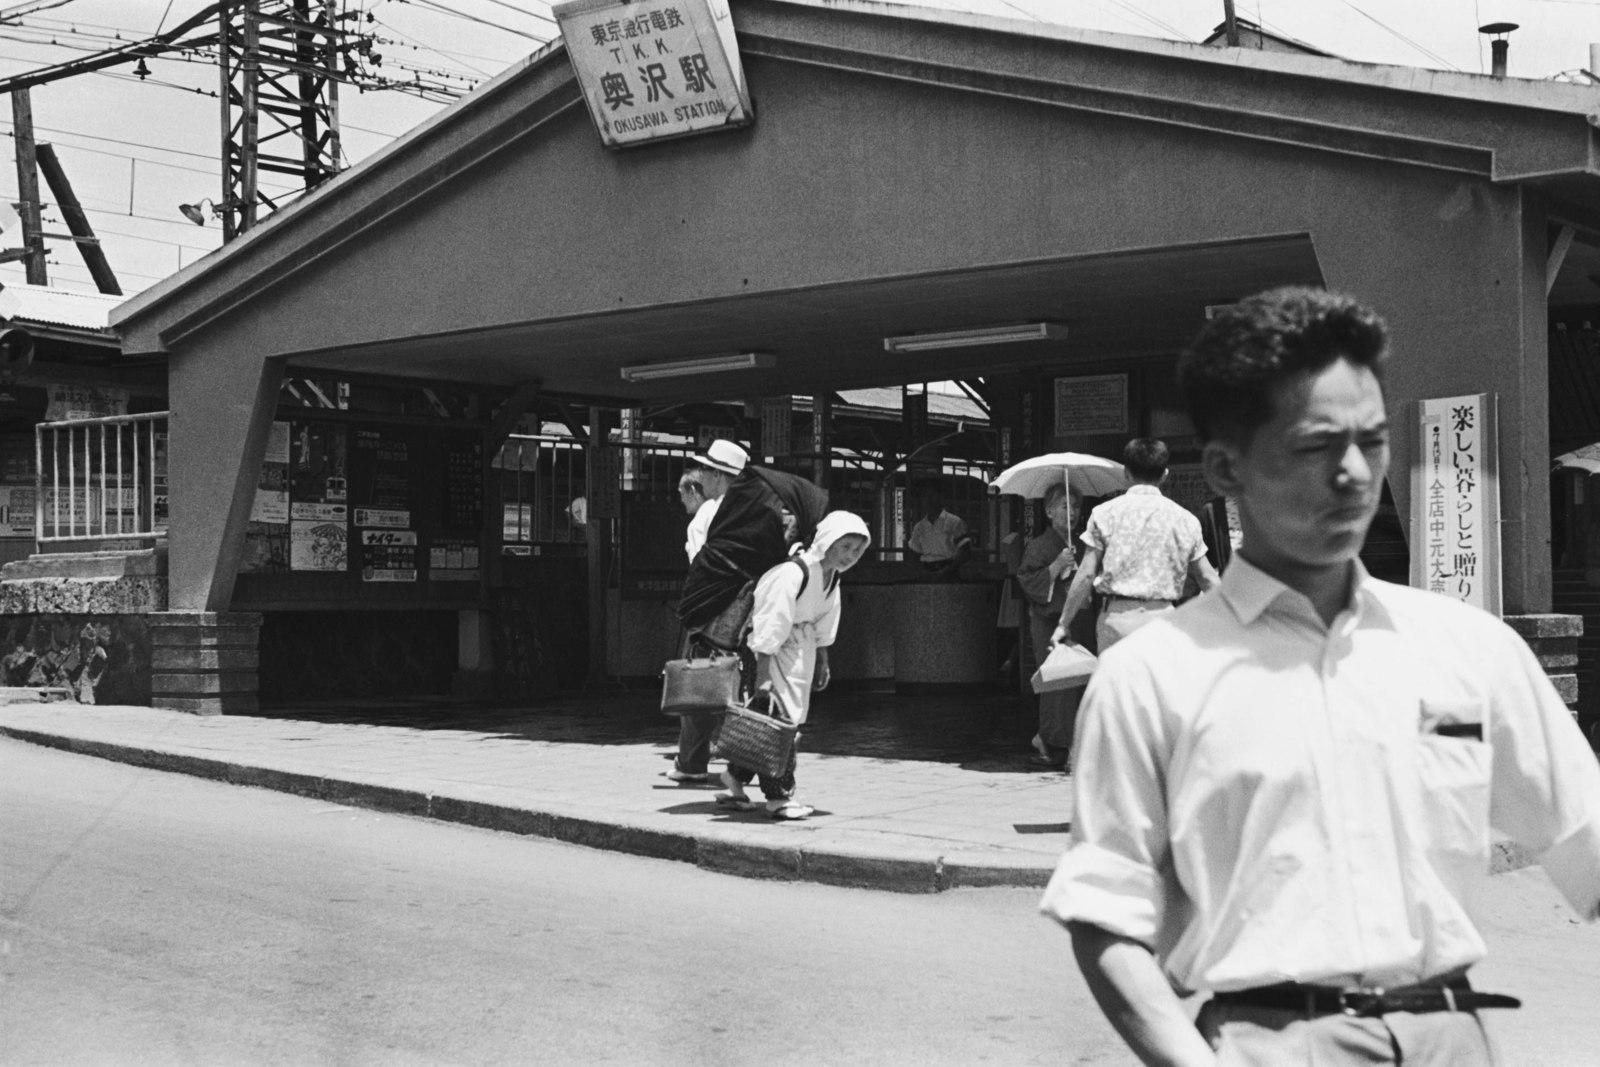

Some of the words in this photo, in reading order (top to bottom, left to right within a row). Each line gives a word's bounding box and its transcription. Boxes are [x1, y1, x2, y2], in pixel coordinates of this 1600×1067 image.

[590, 7, 685, 46] 東京急行電鉄
[600, 53, 717, 111] 奥沢駅
[614, 110, 669, 134] OKUSAWA
[674, 98, 727, 122] STATION
[1452, 405, 1476, 602] 楽しい暮らしと贈り
